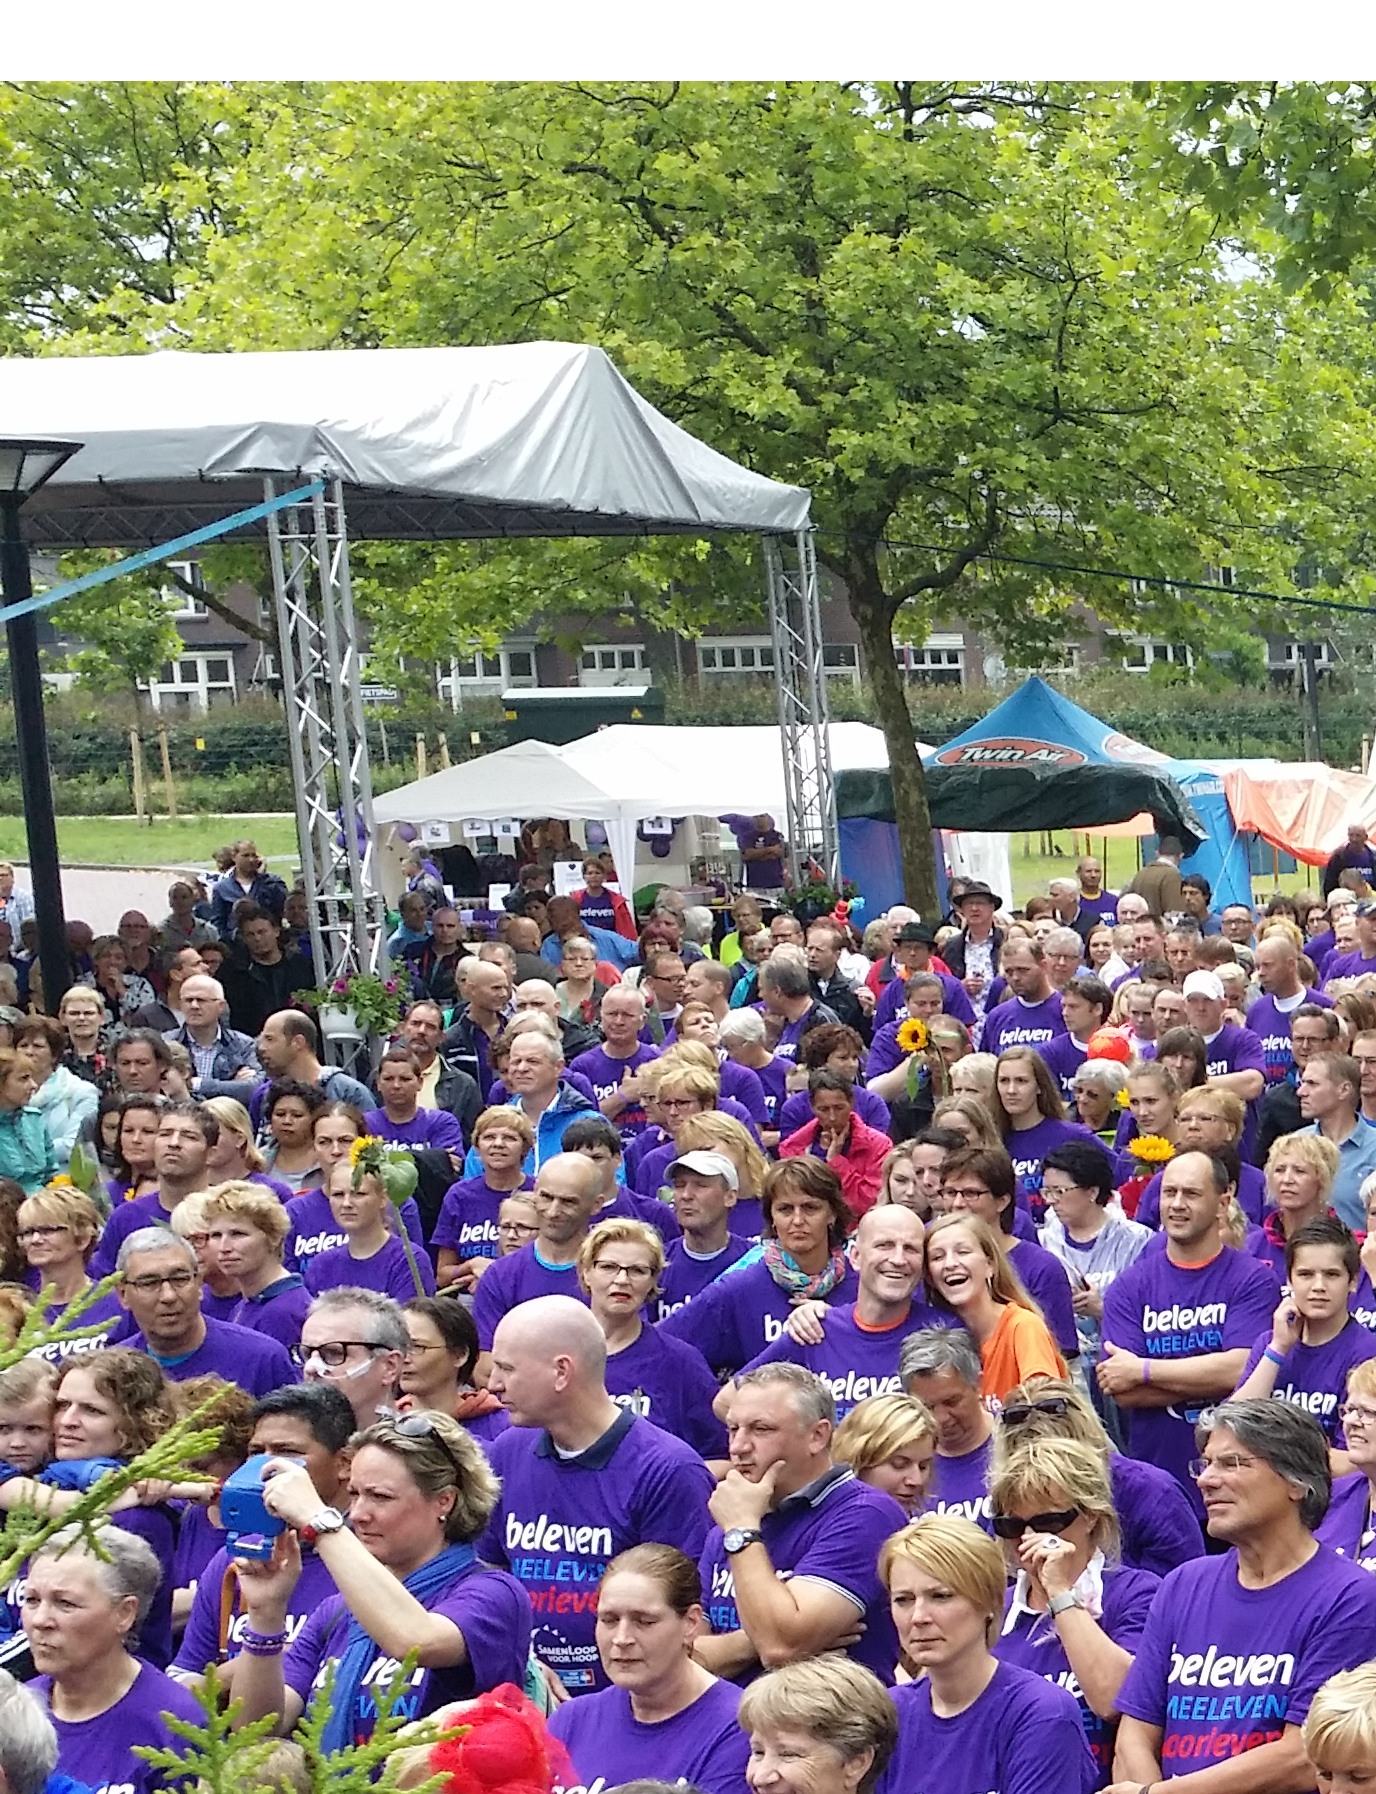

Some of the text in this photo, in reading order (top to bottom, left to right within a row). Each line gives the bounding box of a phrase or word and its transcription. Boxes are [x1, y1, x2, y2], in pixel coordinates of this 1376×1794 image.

[961, 747, 1070, 762] Twin Air
[505, 1513, 612, 1557] beleven
